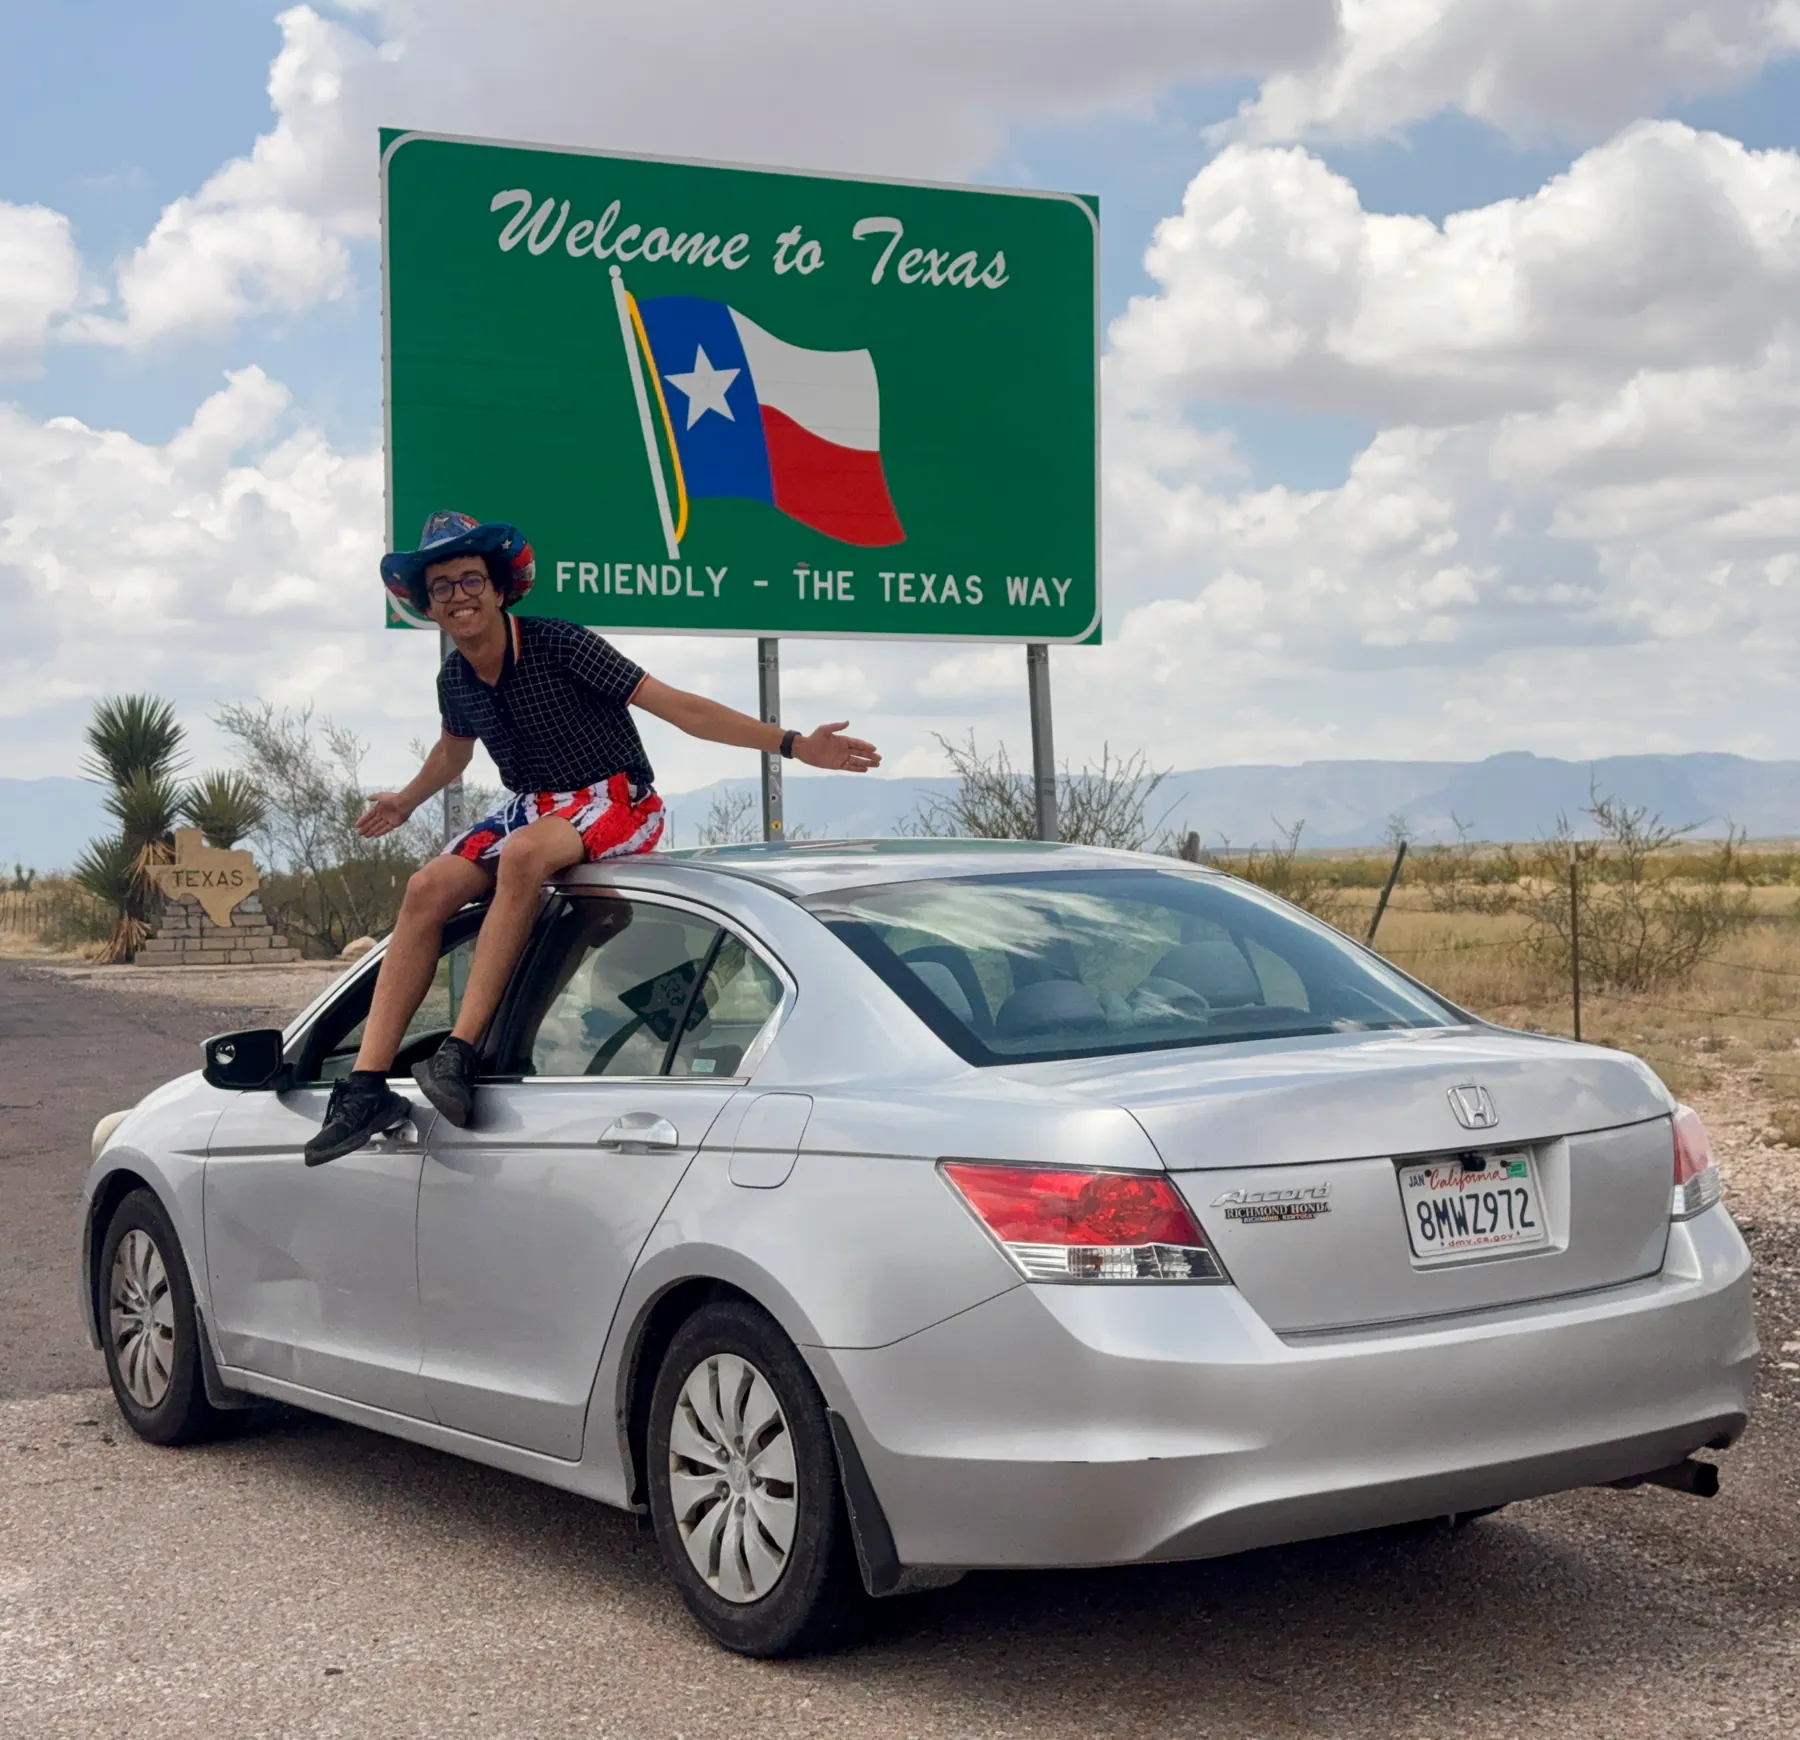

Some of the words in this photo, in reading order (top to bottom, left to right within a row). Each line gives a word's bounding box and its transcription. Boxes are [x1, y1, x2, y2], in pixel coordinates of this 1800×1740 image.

[490, 188, 751, 271] Welcome
[773, 225, 825, 276] to
[852, 216, 1010, 290] Texas
[556, 561, 729, 598] FRIENDLY
[793, 568, 855, 602] THE
[878, 571, 984, 606] TEXAS
[1006, 576, 1073, 608] WAY
[172, 869, 244, 888] TEXAS
[1408, 1174, 1426, 1188] JAN
[1429, 1168, 1509, 1192] California
[1209, 1181, 1333, 1208] Accord
[1225, 1204, 1288, 1219] RICHMOND
[1290, 1202, 1333, 1215] HONDA
[1416, 1187, 1535, 1241] 8MWZ972
[1447, 1232, 1514, 1248] dmv.ca.gov
